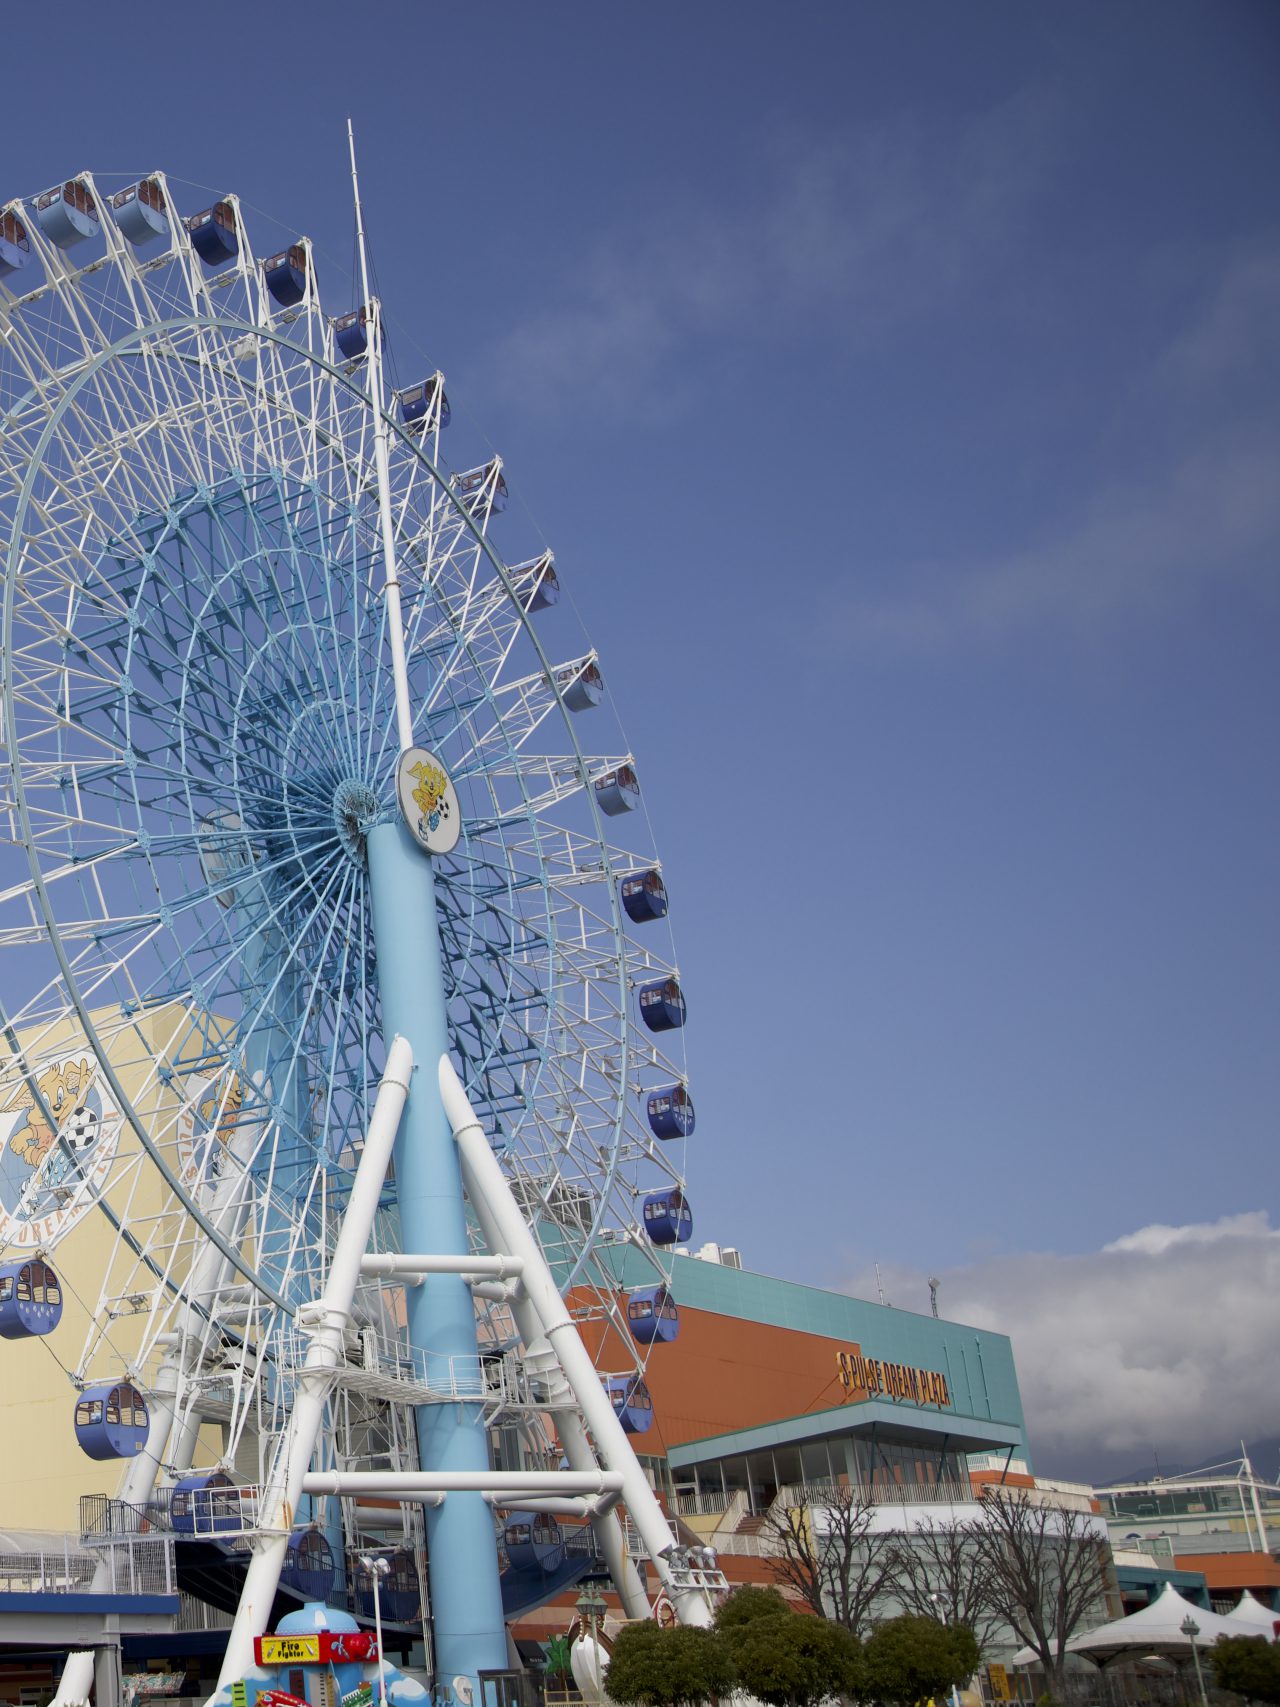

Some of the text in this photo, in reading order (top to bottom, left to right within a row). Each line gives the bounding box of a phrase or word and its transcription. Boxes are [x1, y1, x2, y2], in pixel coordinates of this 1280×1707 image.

[881, 1361, 919, 1401] DREAM
[918, 1369, 950, 1406] PLAZA
[281, 1641, 300, 1651] Fire
[277, 1650, 304, 1659] Fighter
